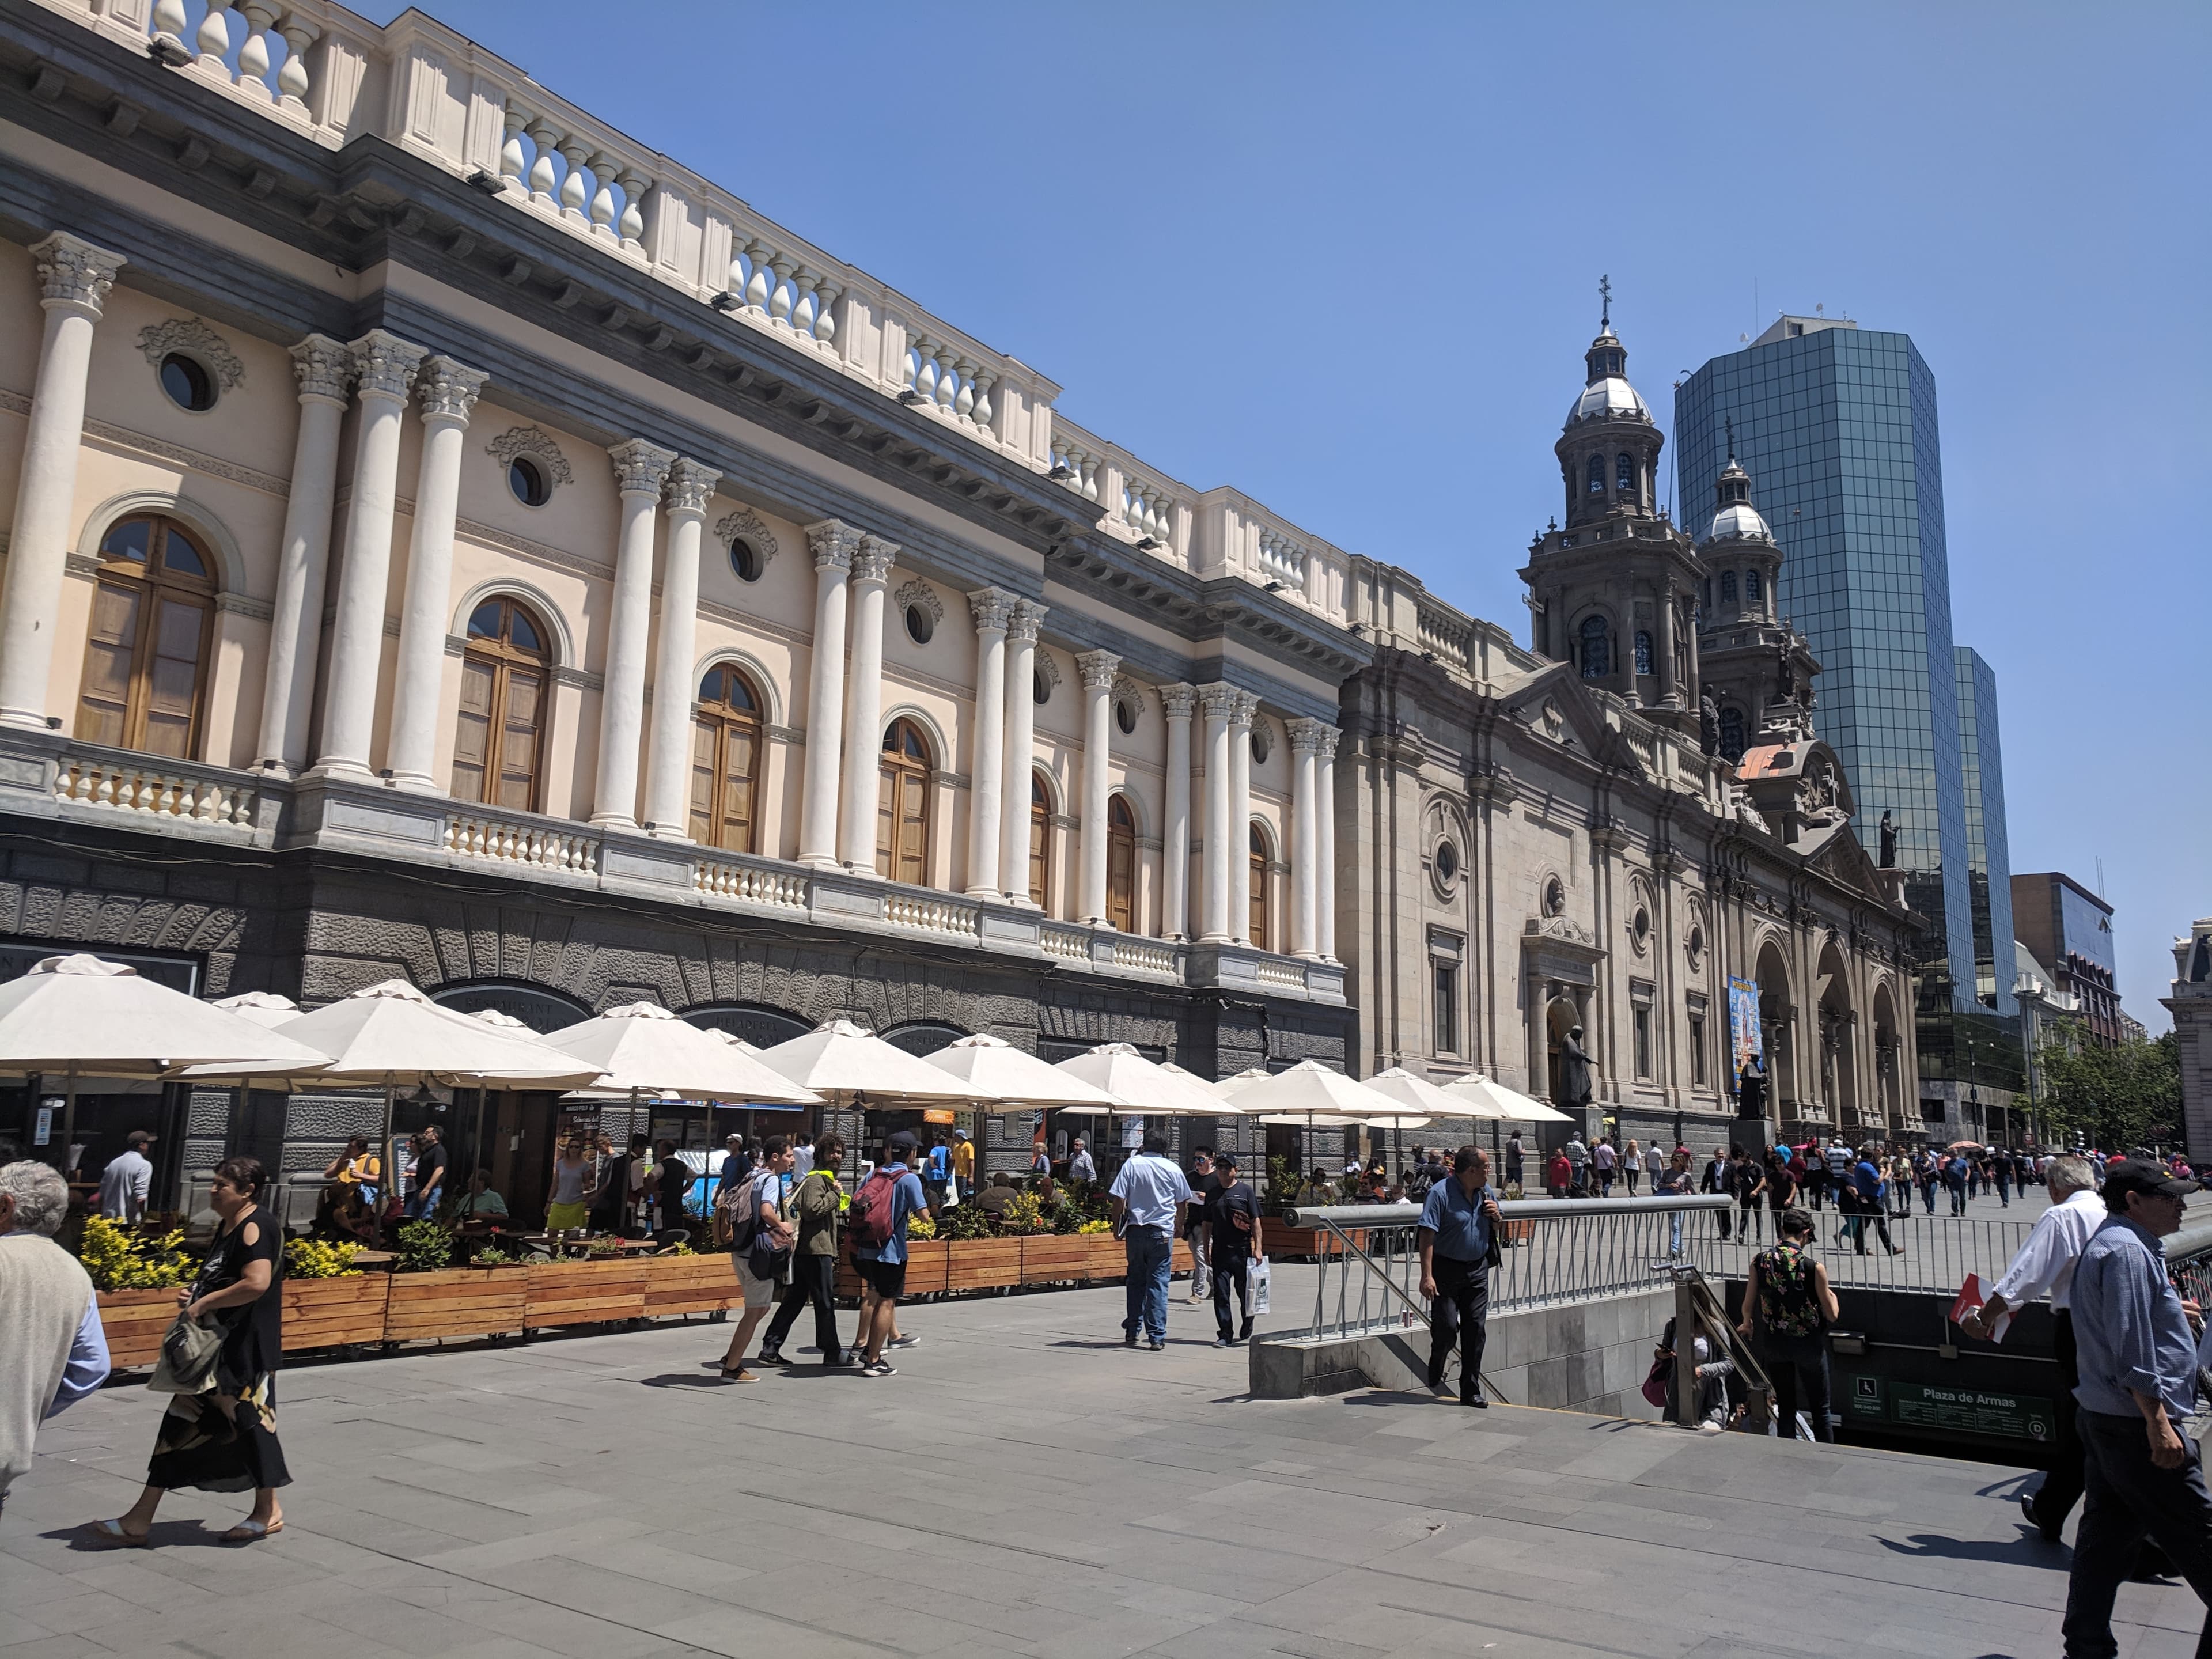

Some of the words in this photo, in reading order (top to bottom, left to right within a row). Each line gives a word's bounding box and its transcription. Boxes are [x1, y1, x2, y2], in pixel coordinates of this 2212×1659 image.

[465, 997, 552, 1015] RESTAURANT
[1923, 1388, 1956, 1401] Plaza
[1958, 1392, 1974, 1403] de
[1976, 1394, 2016, 1408] Armas
[2033, 1424, 2042, 1433] D
